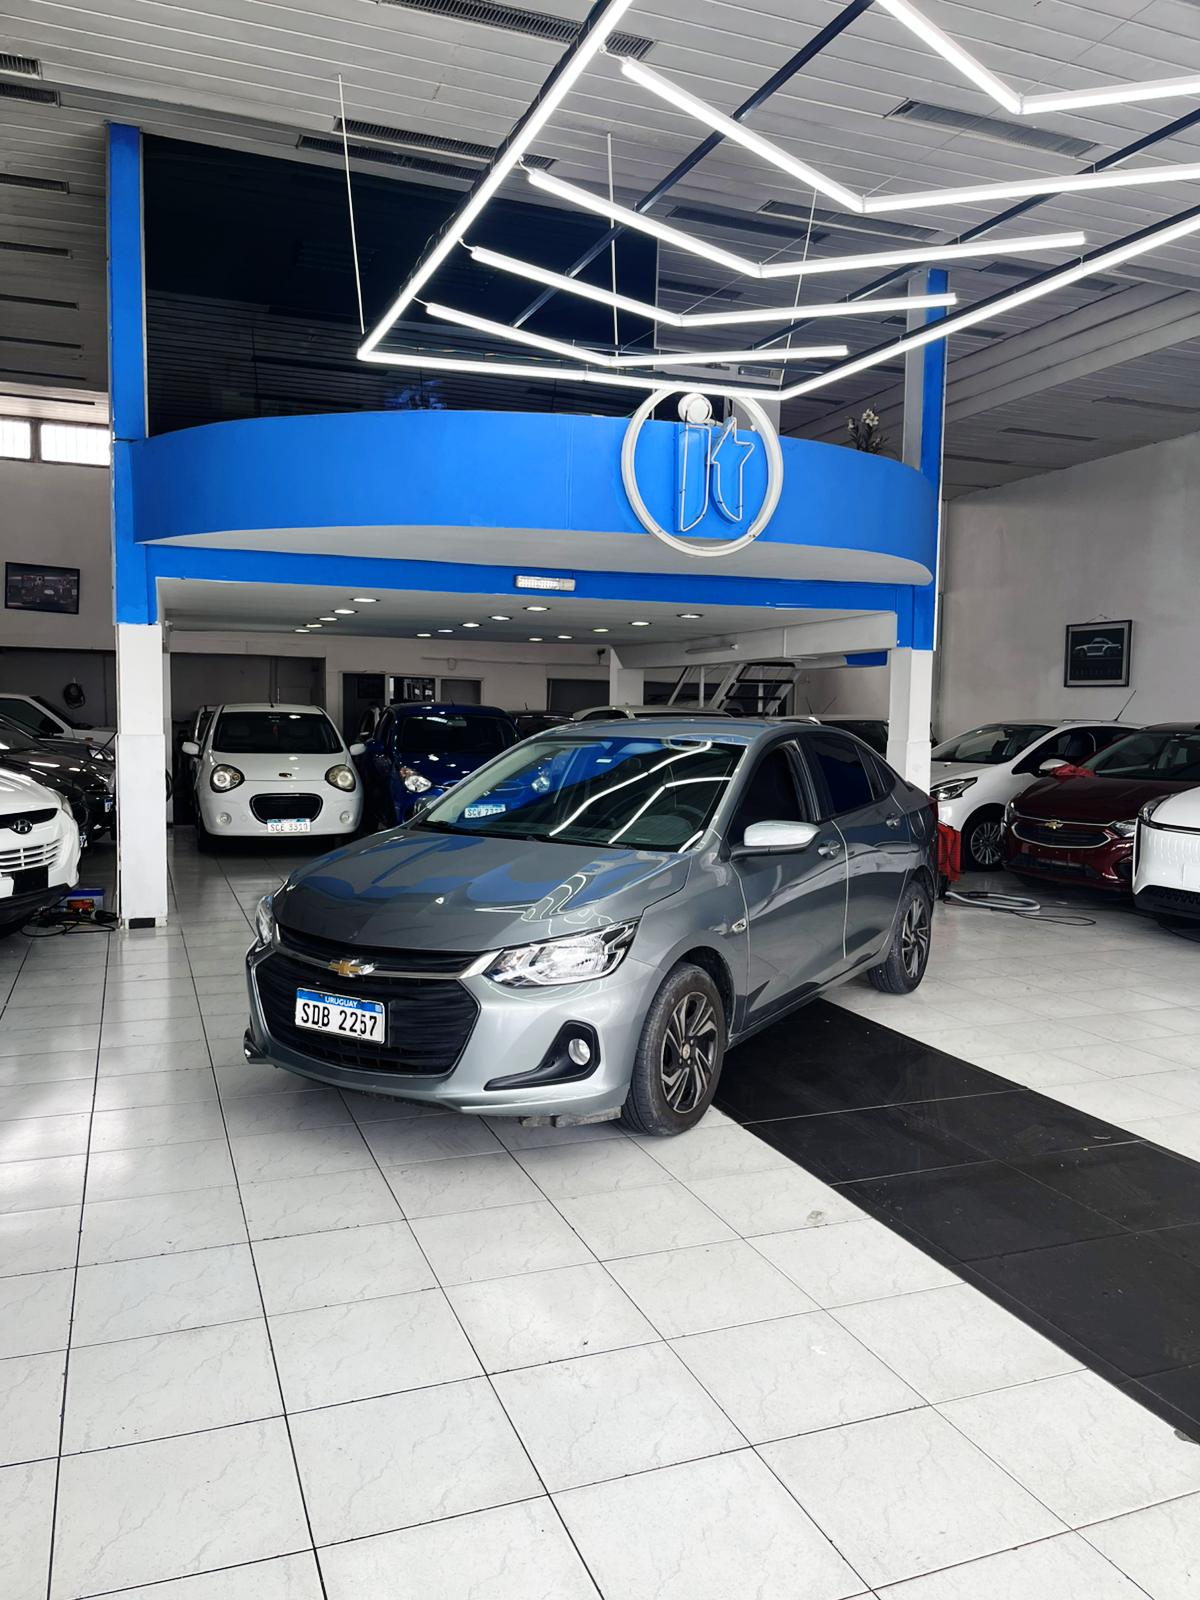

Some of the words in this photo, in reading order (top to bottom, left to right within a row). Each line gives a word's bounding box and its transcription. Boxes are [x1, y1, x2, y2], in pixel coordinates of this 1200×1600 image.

[324, 996, 358, 1008] URUGUAY
[301, 1003, 331, 1027] SDB
[338, 1010, 378, 1037] 2257
